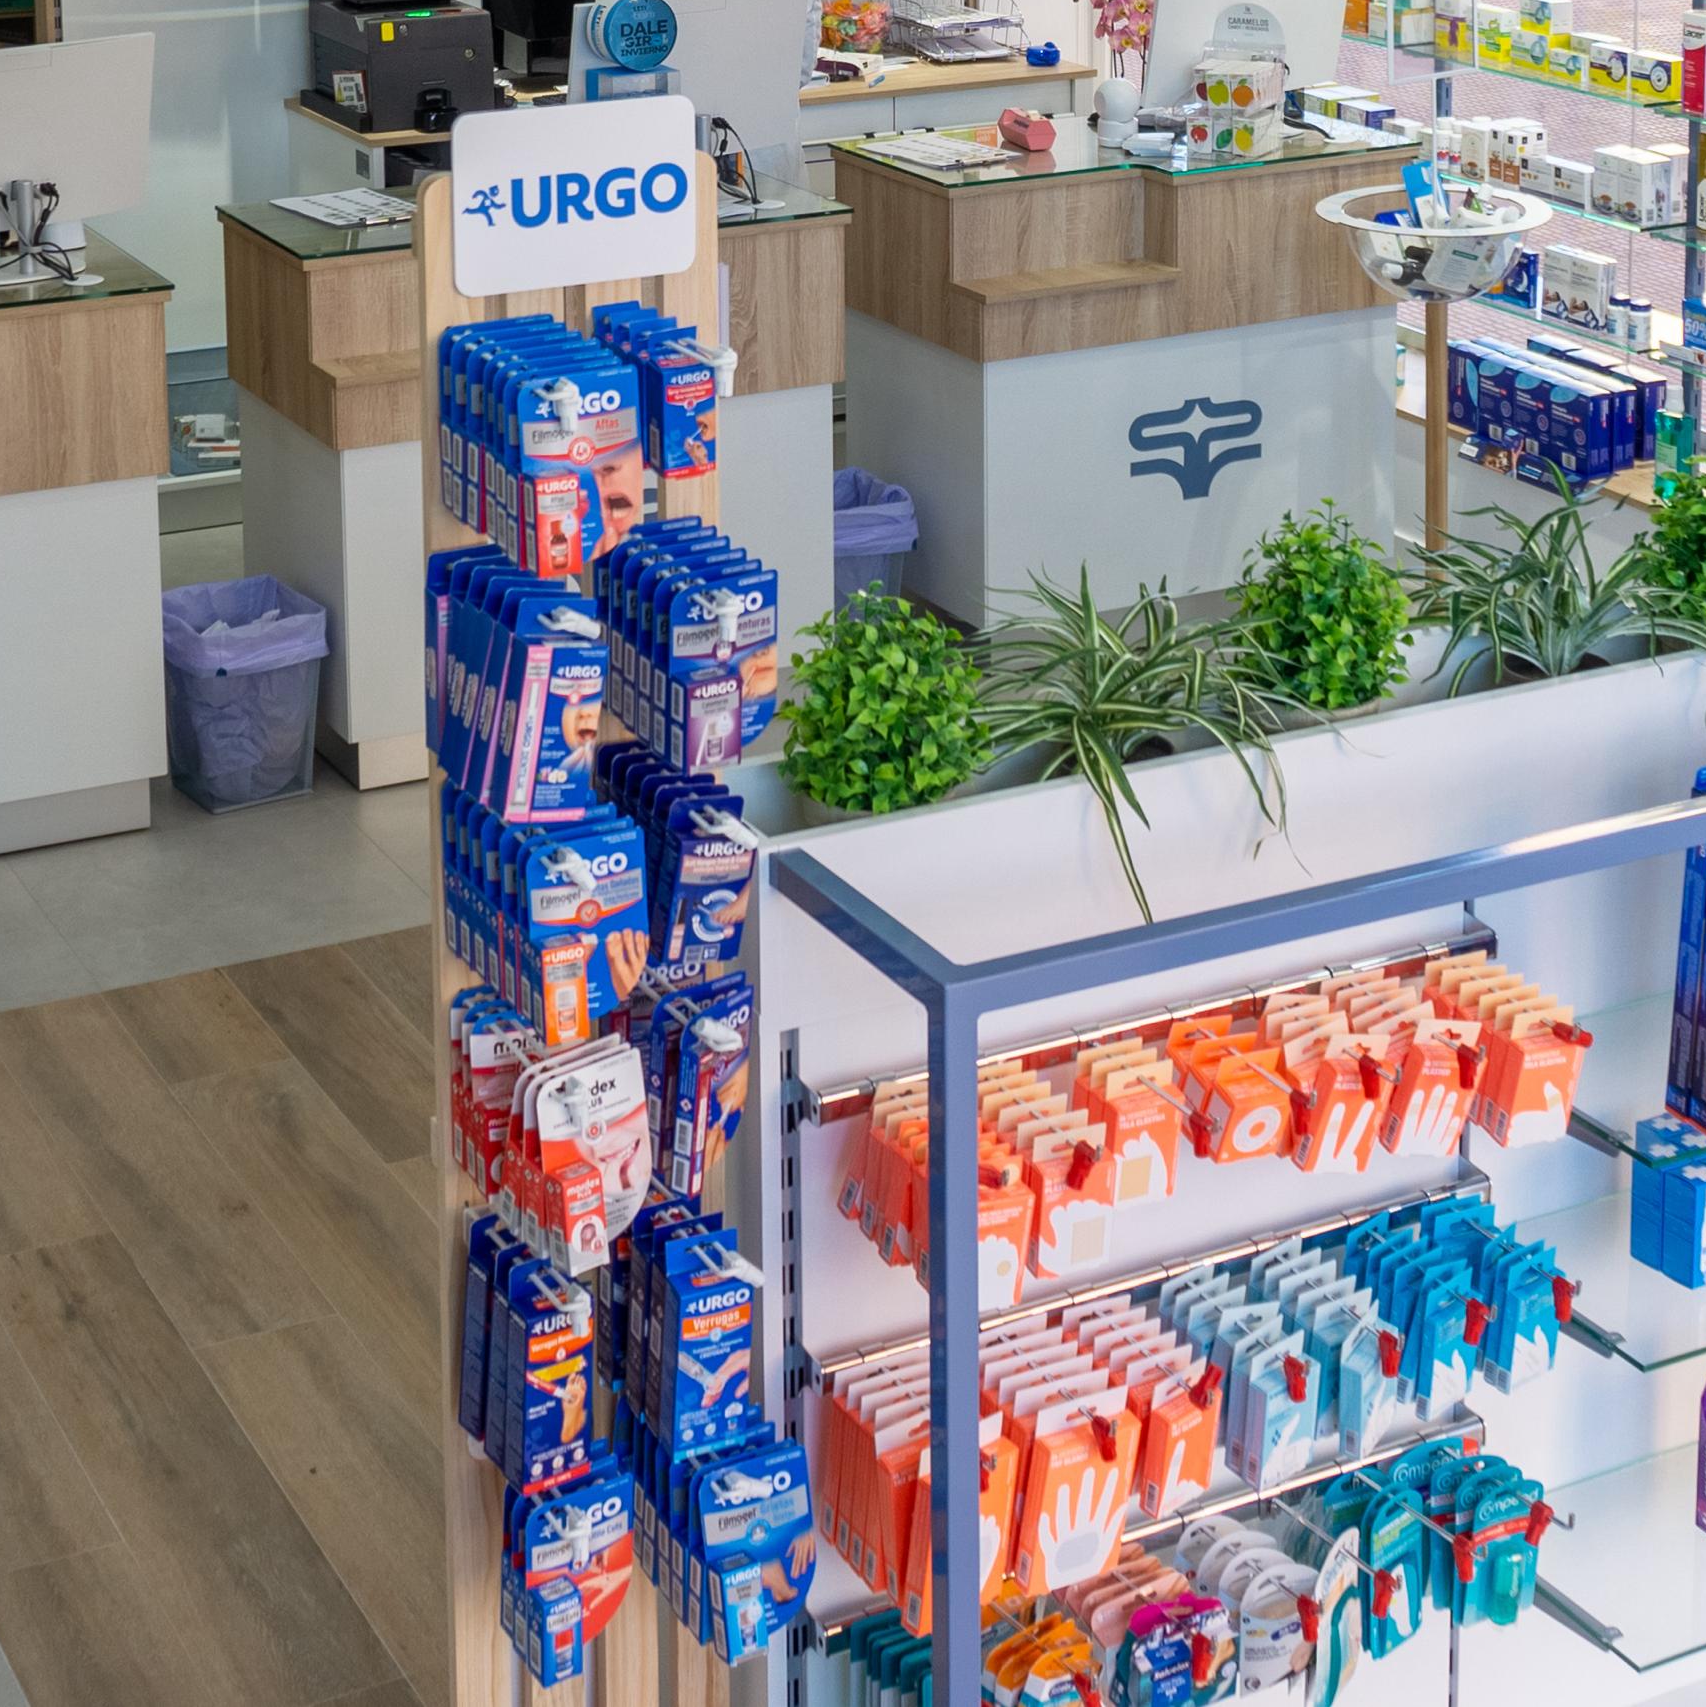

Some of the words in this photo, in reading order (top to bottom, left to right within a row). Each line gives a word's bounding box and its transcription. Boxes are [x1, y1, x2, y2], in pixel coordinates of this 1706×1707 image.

[621, 19, 668, 36] DALE
[621, 45, 669, 58] INVIERNO
[511, 162, 688, 228] URGO
[678, 371, 710, 384] URGO
[545, 480, 578, 493] URGO
[565, 665, 601, 677] URGO
[701, 680, 737, 698] URGO
[551, 947, 584, 963] URGO
[698, 1288, 750, 1313] URGO
[693, 1310, 739, 1331] Verrugas
[732, 1568, 761, 1584] URGO
[557, 1598, 578, 1614] URGO
